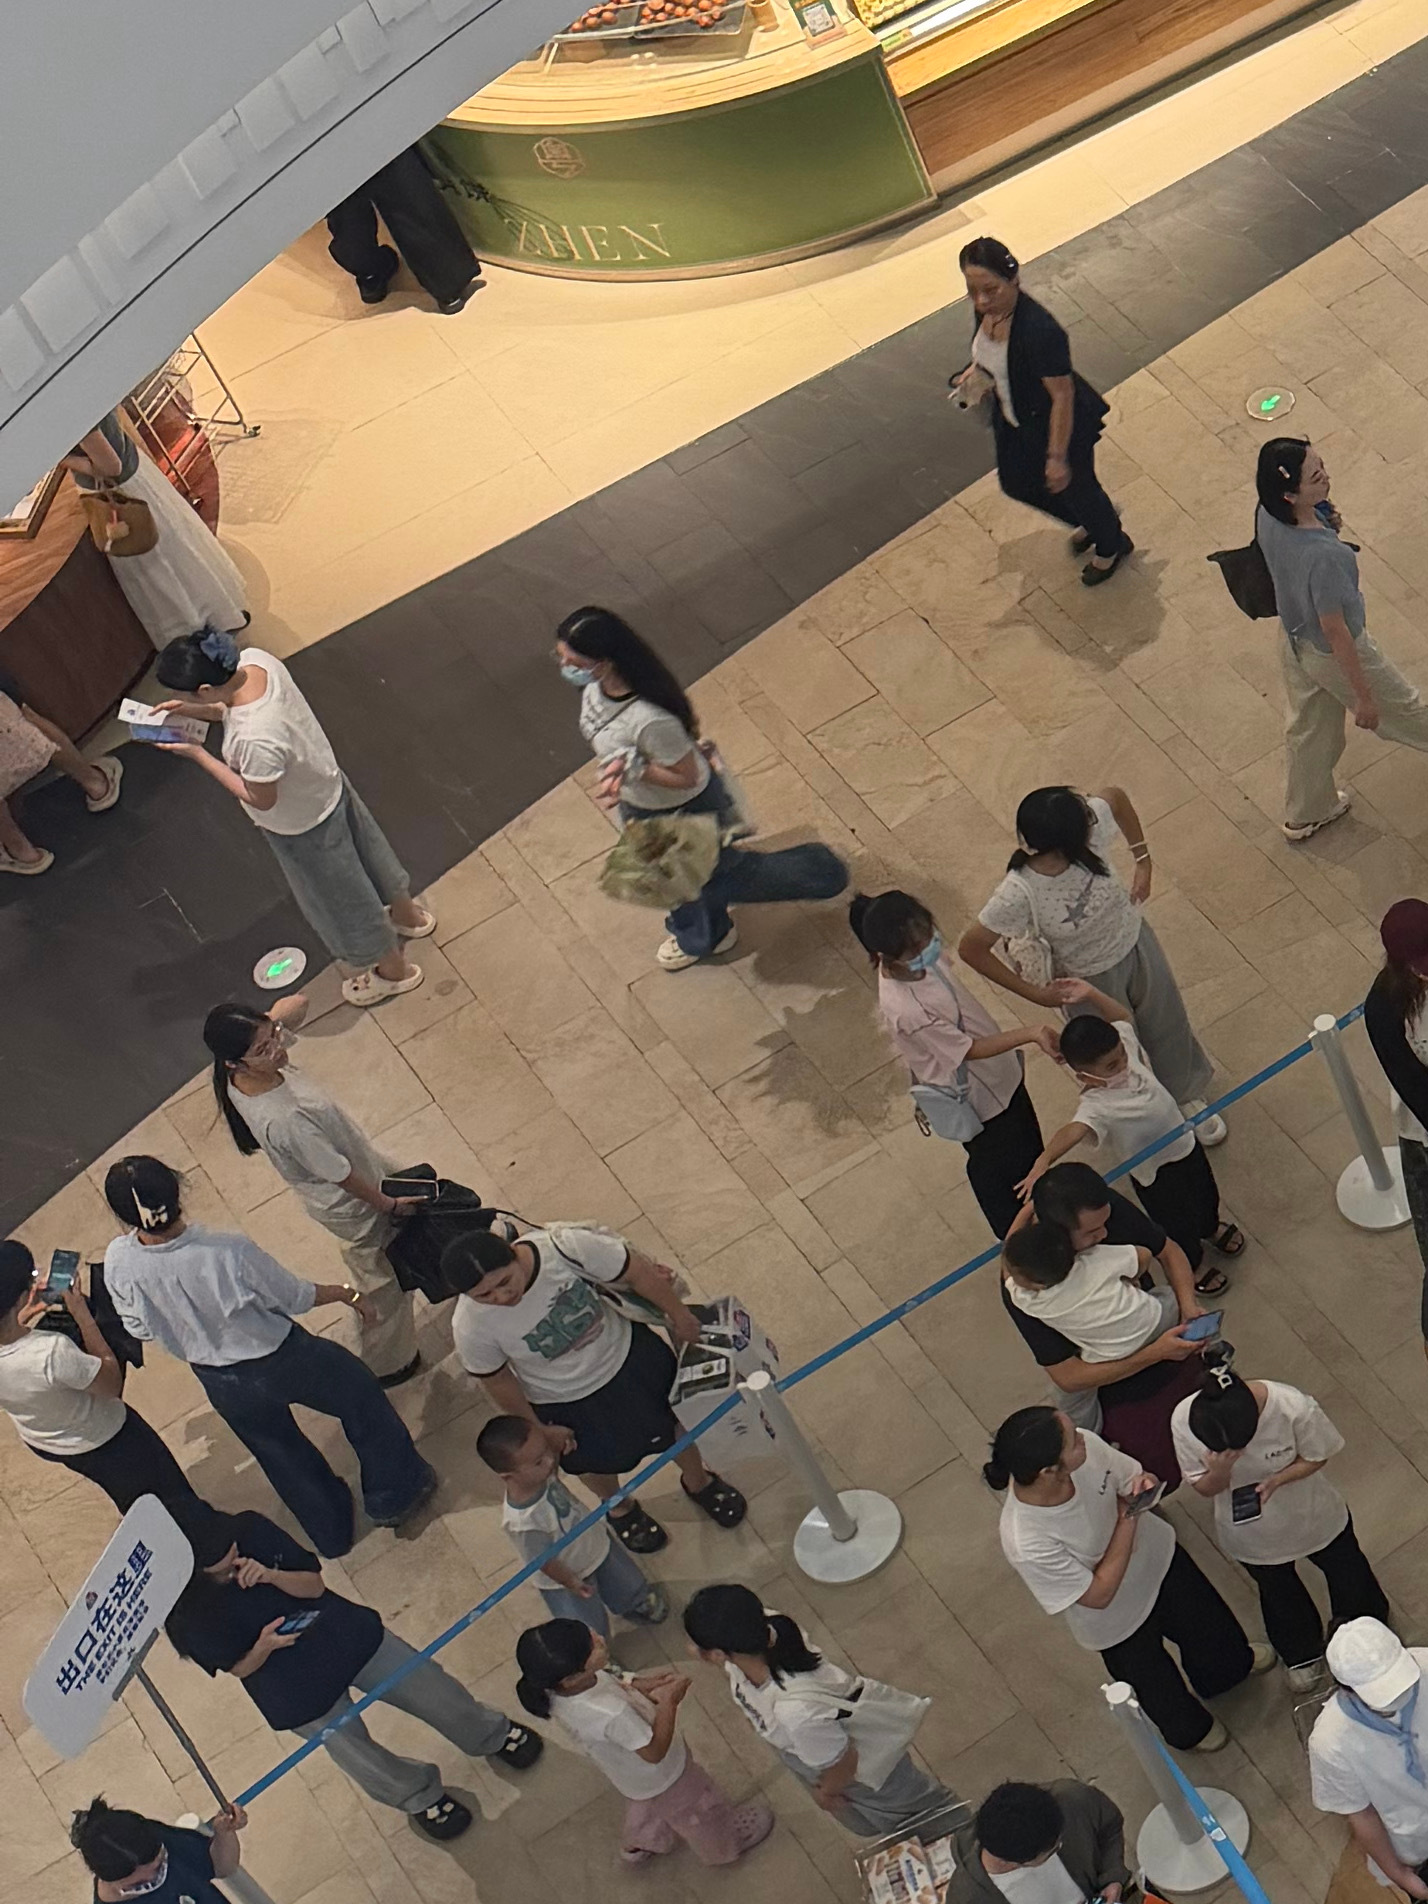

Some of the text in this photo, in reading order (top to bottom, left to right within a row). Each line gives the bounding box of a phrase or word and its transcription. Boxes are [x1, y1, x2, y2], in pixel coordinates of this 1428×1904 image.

[504, 217, 671, 261] ZHEN
[56, 1539, 153, 1695] 出口在这里
[95, 1624, 117, 1662] EXIT
